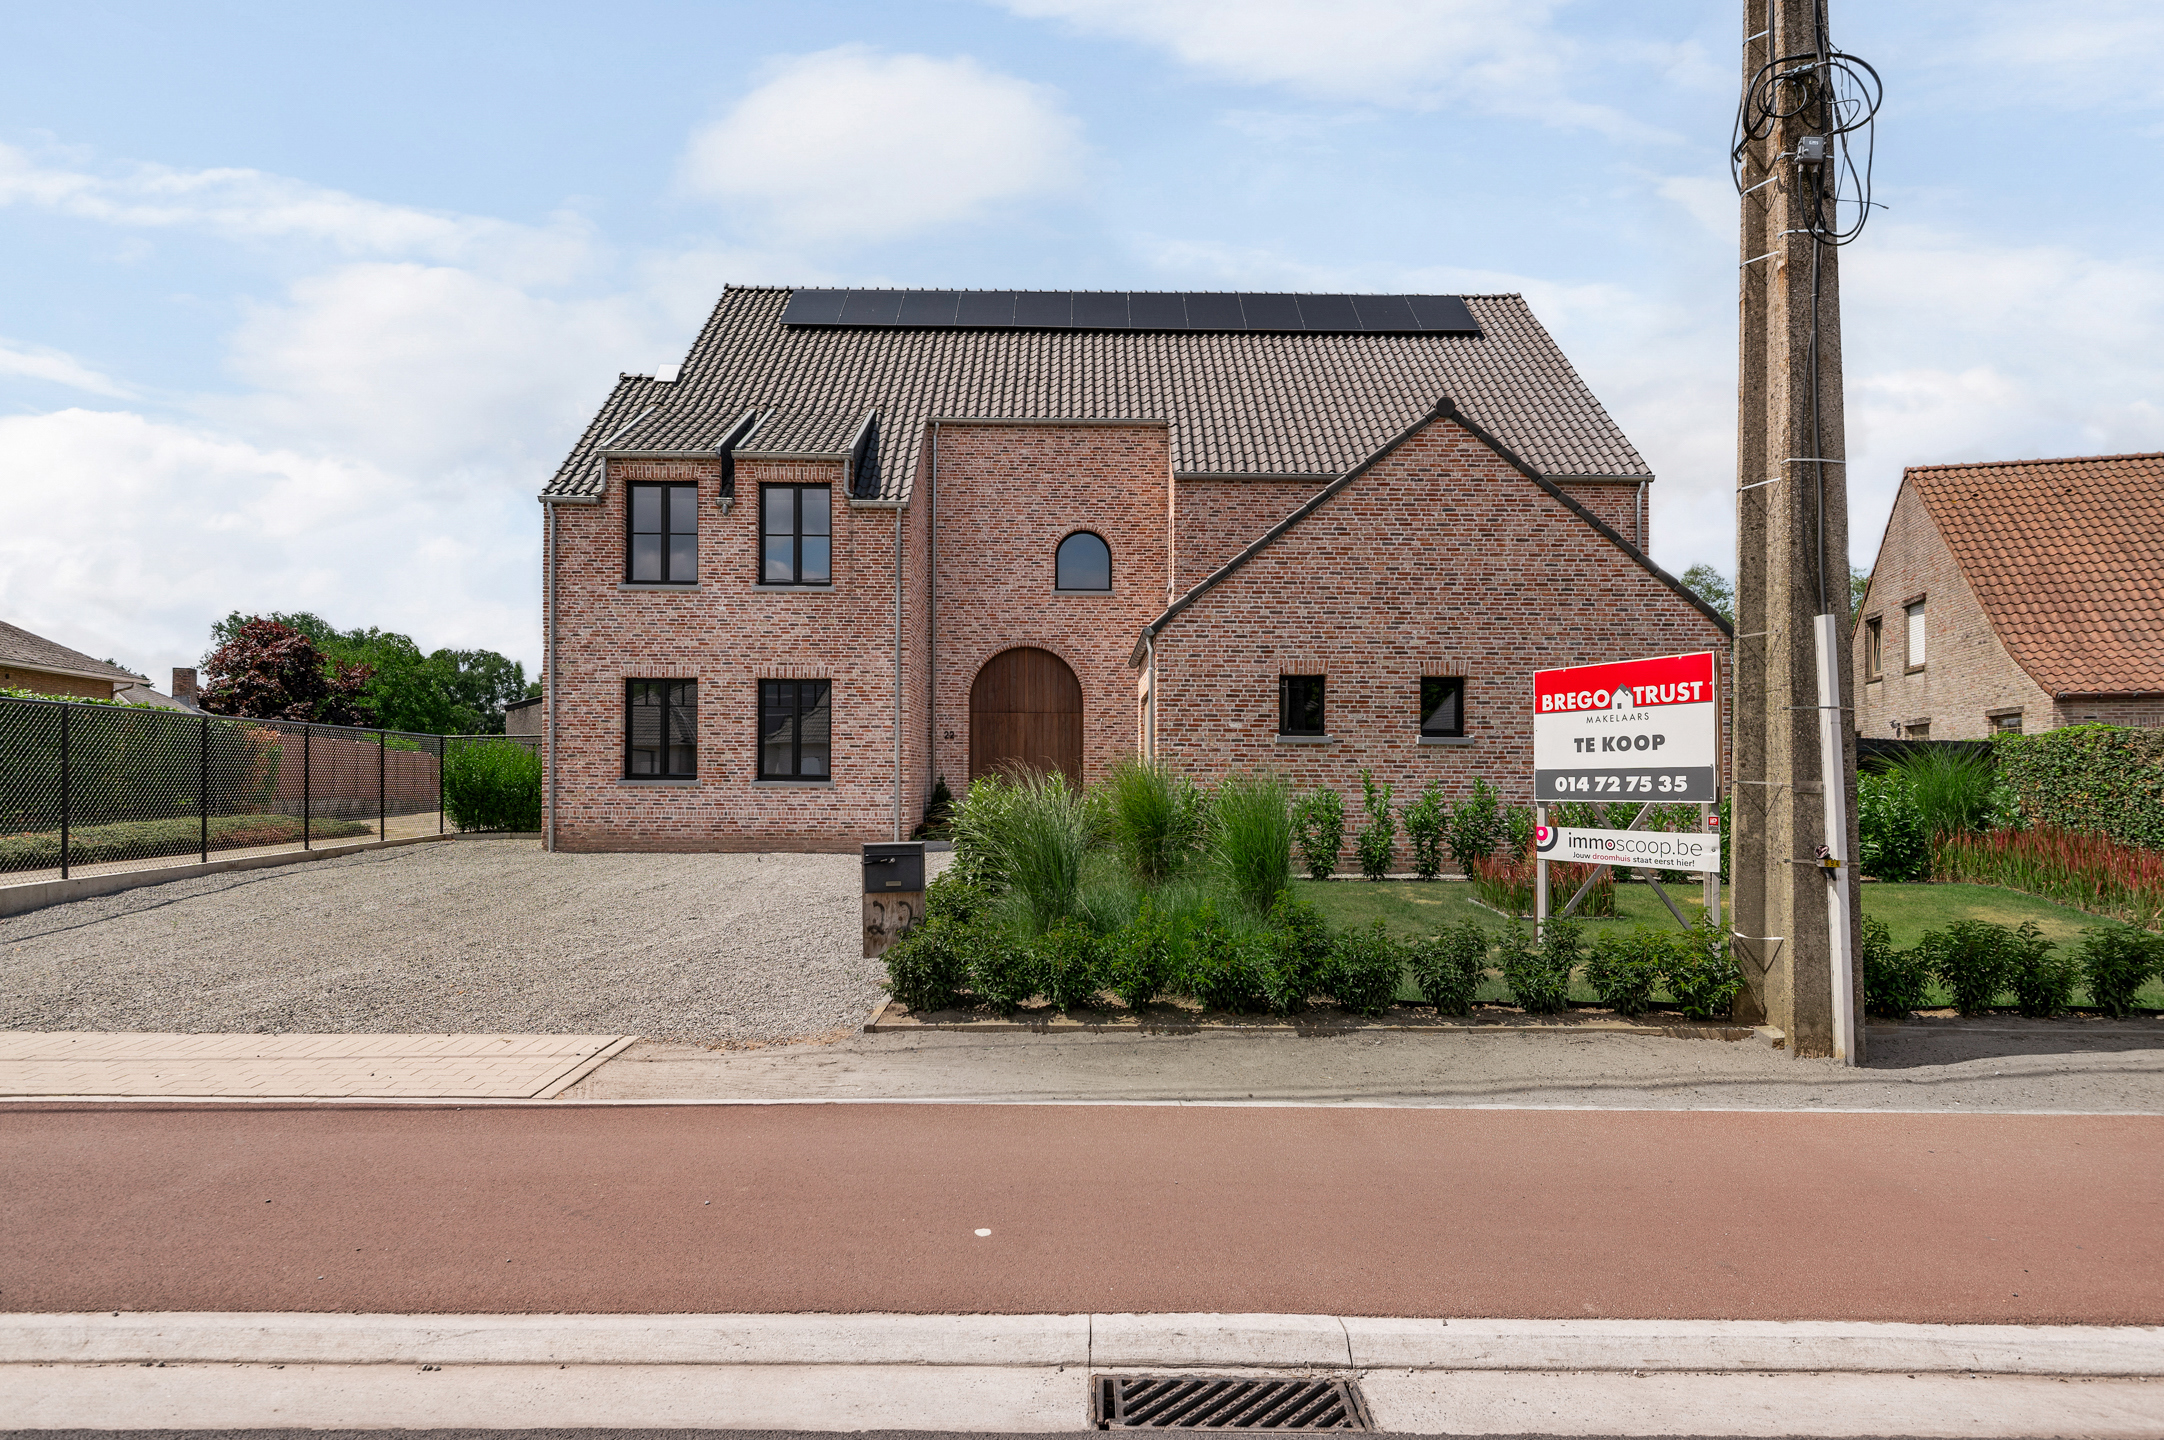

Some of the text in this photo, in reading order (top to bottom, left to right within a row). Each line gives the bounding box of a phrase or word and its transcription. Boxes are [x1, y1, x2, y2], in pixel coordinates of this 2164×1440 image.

[1542, 681, 1703, 711] BREGO TRUST
[1586, 712, 1650, 724] MAKELAARS
[944, 731, 954, 739] 22
[1574, 734, 1666, 753] TE KOOP
[1554, 775, 1688, 792] 014 72 75 35
[1568, 832, 1703, 858] immoscoop.be
[1573, 851, 1695, 867] Jouw droomhuis staat eerst hier!
